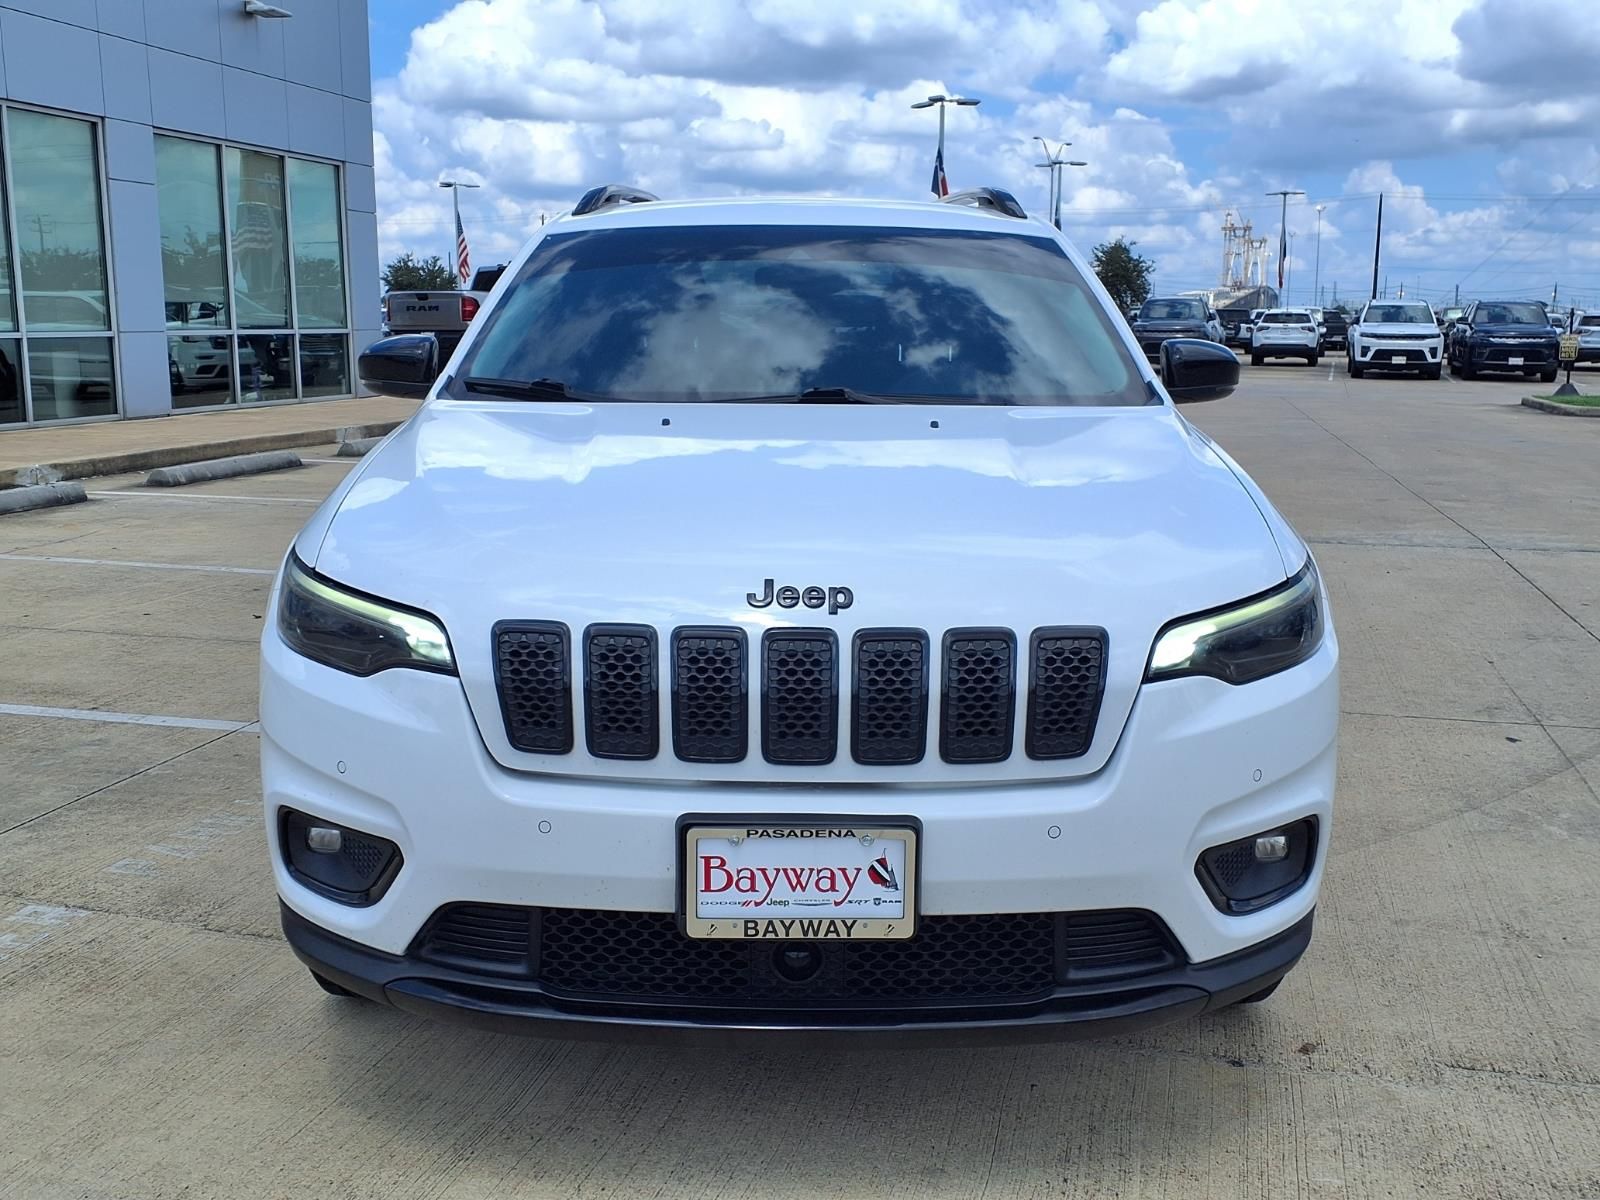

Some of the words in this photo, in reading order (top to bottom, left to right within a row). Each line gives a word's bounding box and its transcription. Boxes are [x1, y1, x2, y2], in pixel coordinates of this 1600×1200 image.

[746, 578, 854, 615] Jeep
[746, 829, 857, 839] PASADENA
[699, 855, 863, 907] Bayway
[766, 898, 790, 907] Jeep
[743, 919, 858, 938] BAYWAY
